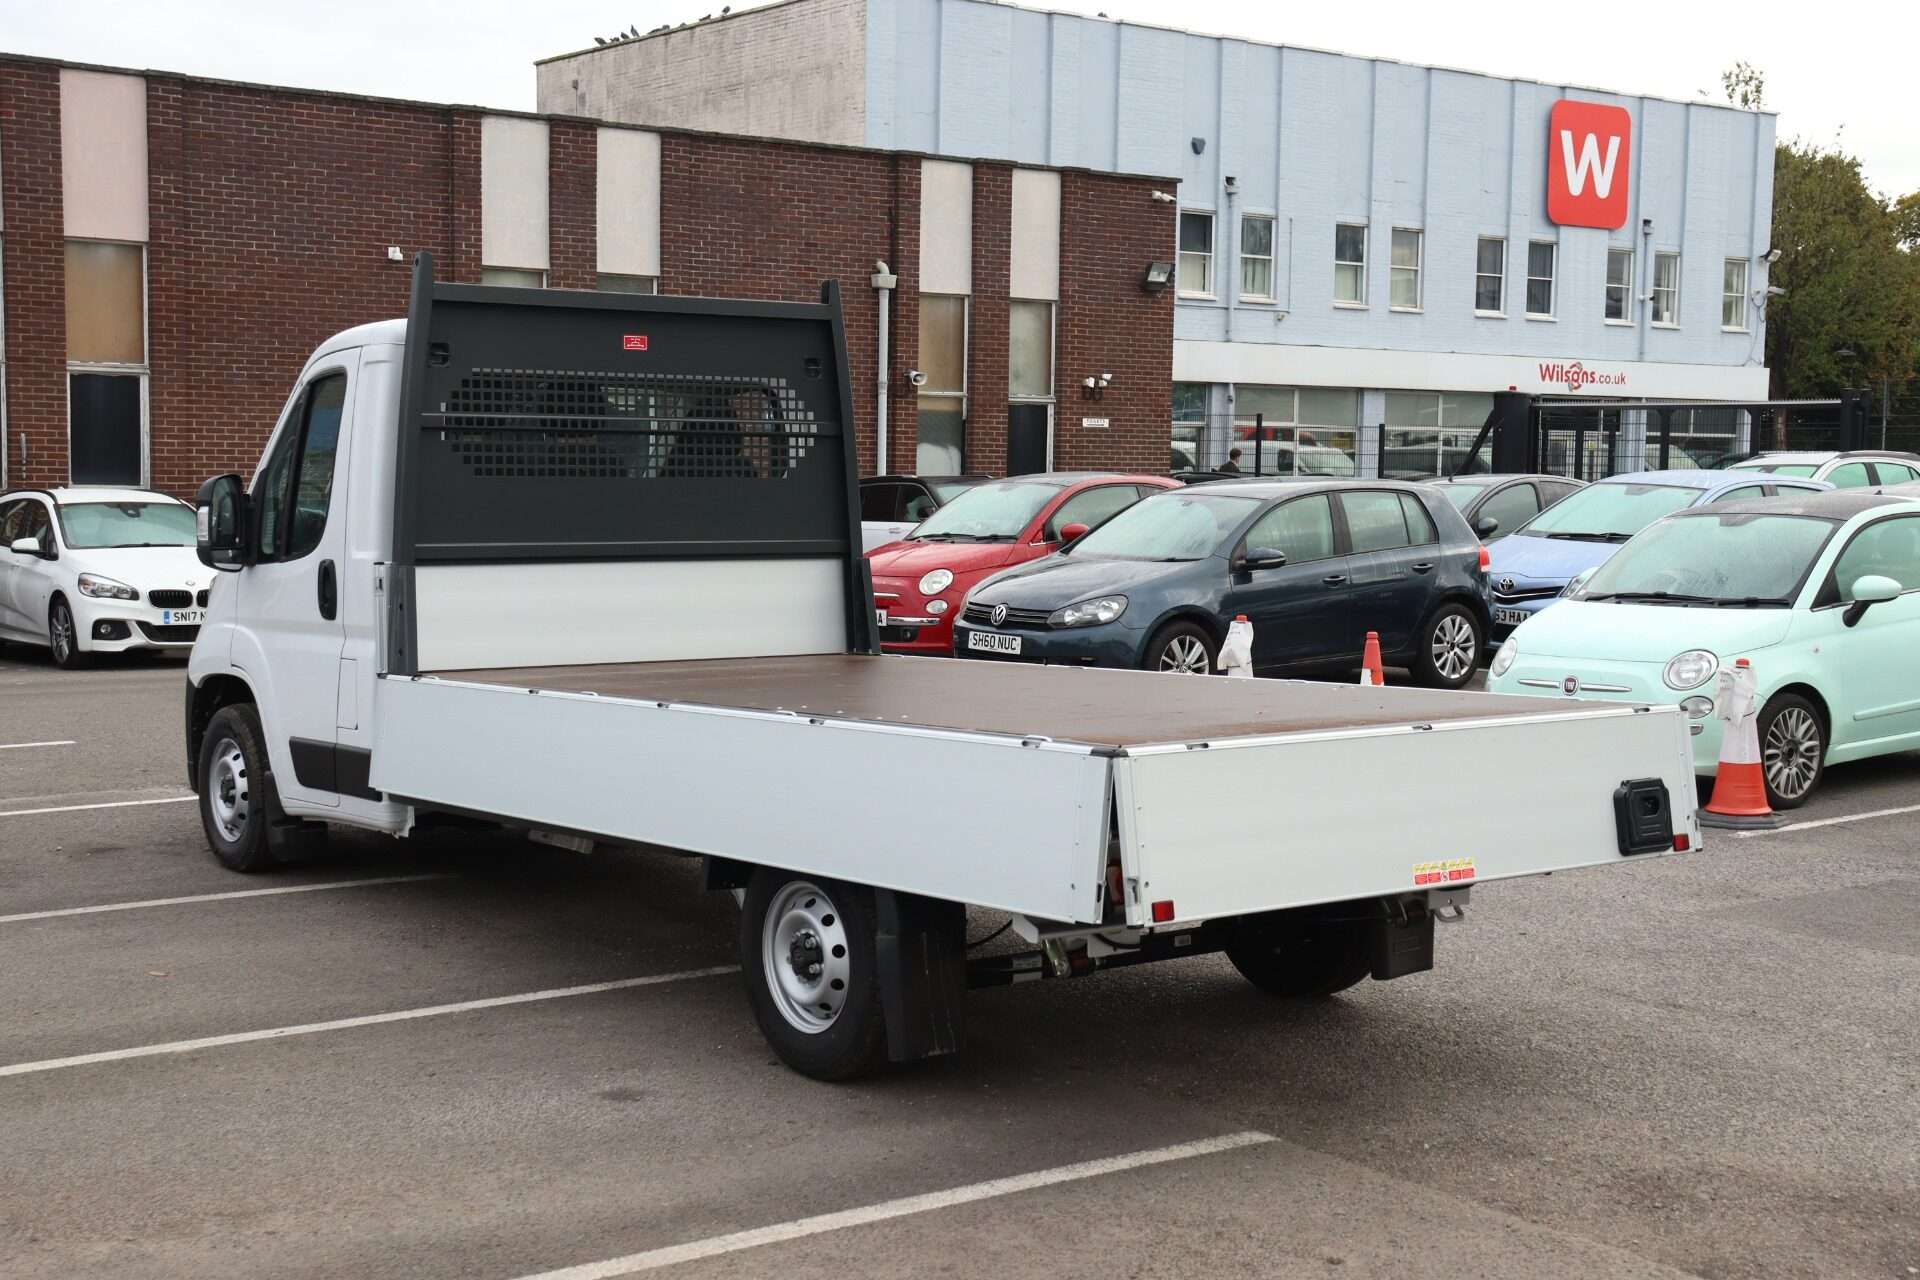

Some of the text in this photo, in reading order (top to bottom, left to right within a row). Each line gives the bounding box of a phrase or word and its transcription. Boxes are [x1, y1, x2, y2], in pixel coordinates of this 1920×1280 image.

[1560, 129, 1621, 199] W
[1539, 362, 1626, 387] Wilsons.co.uk
[173, 611, 197, 622] SN17
[972, 633, 1017, 651] SH60 NUC
